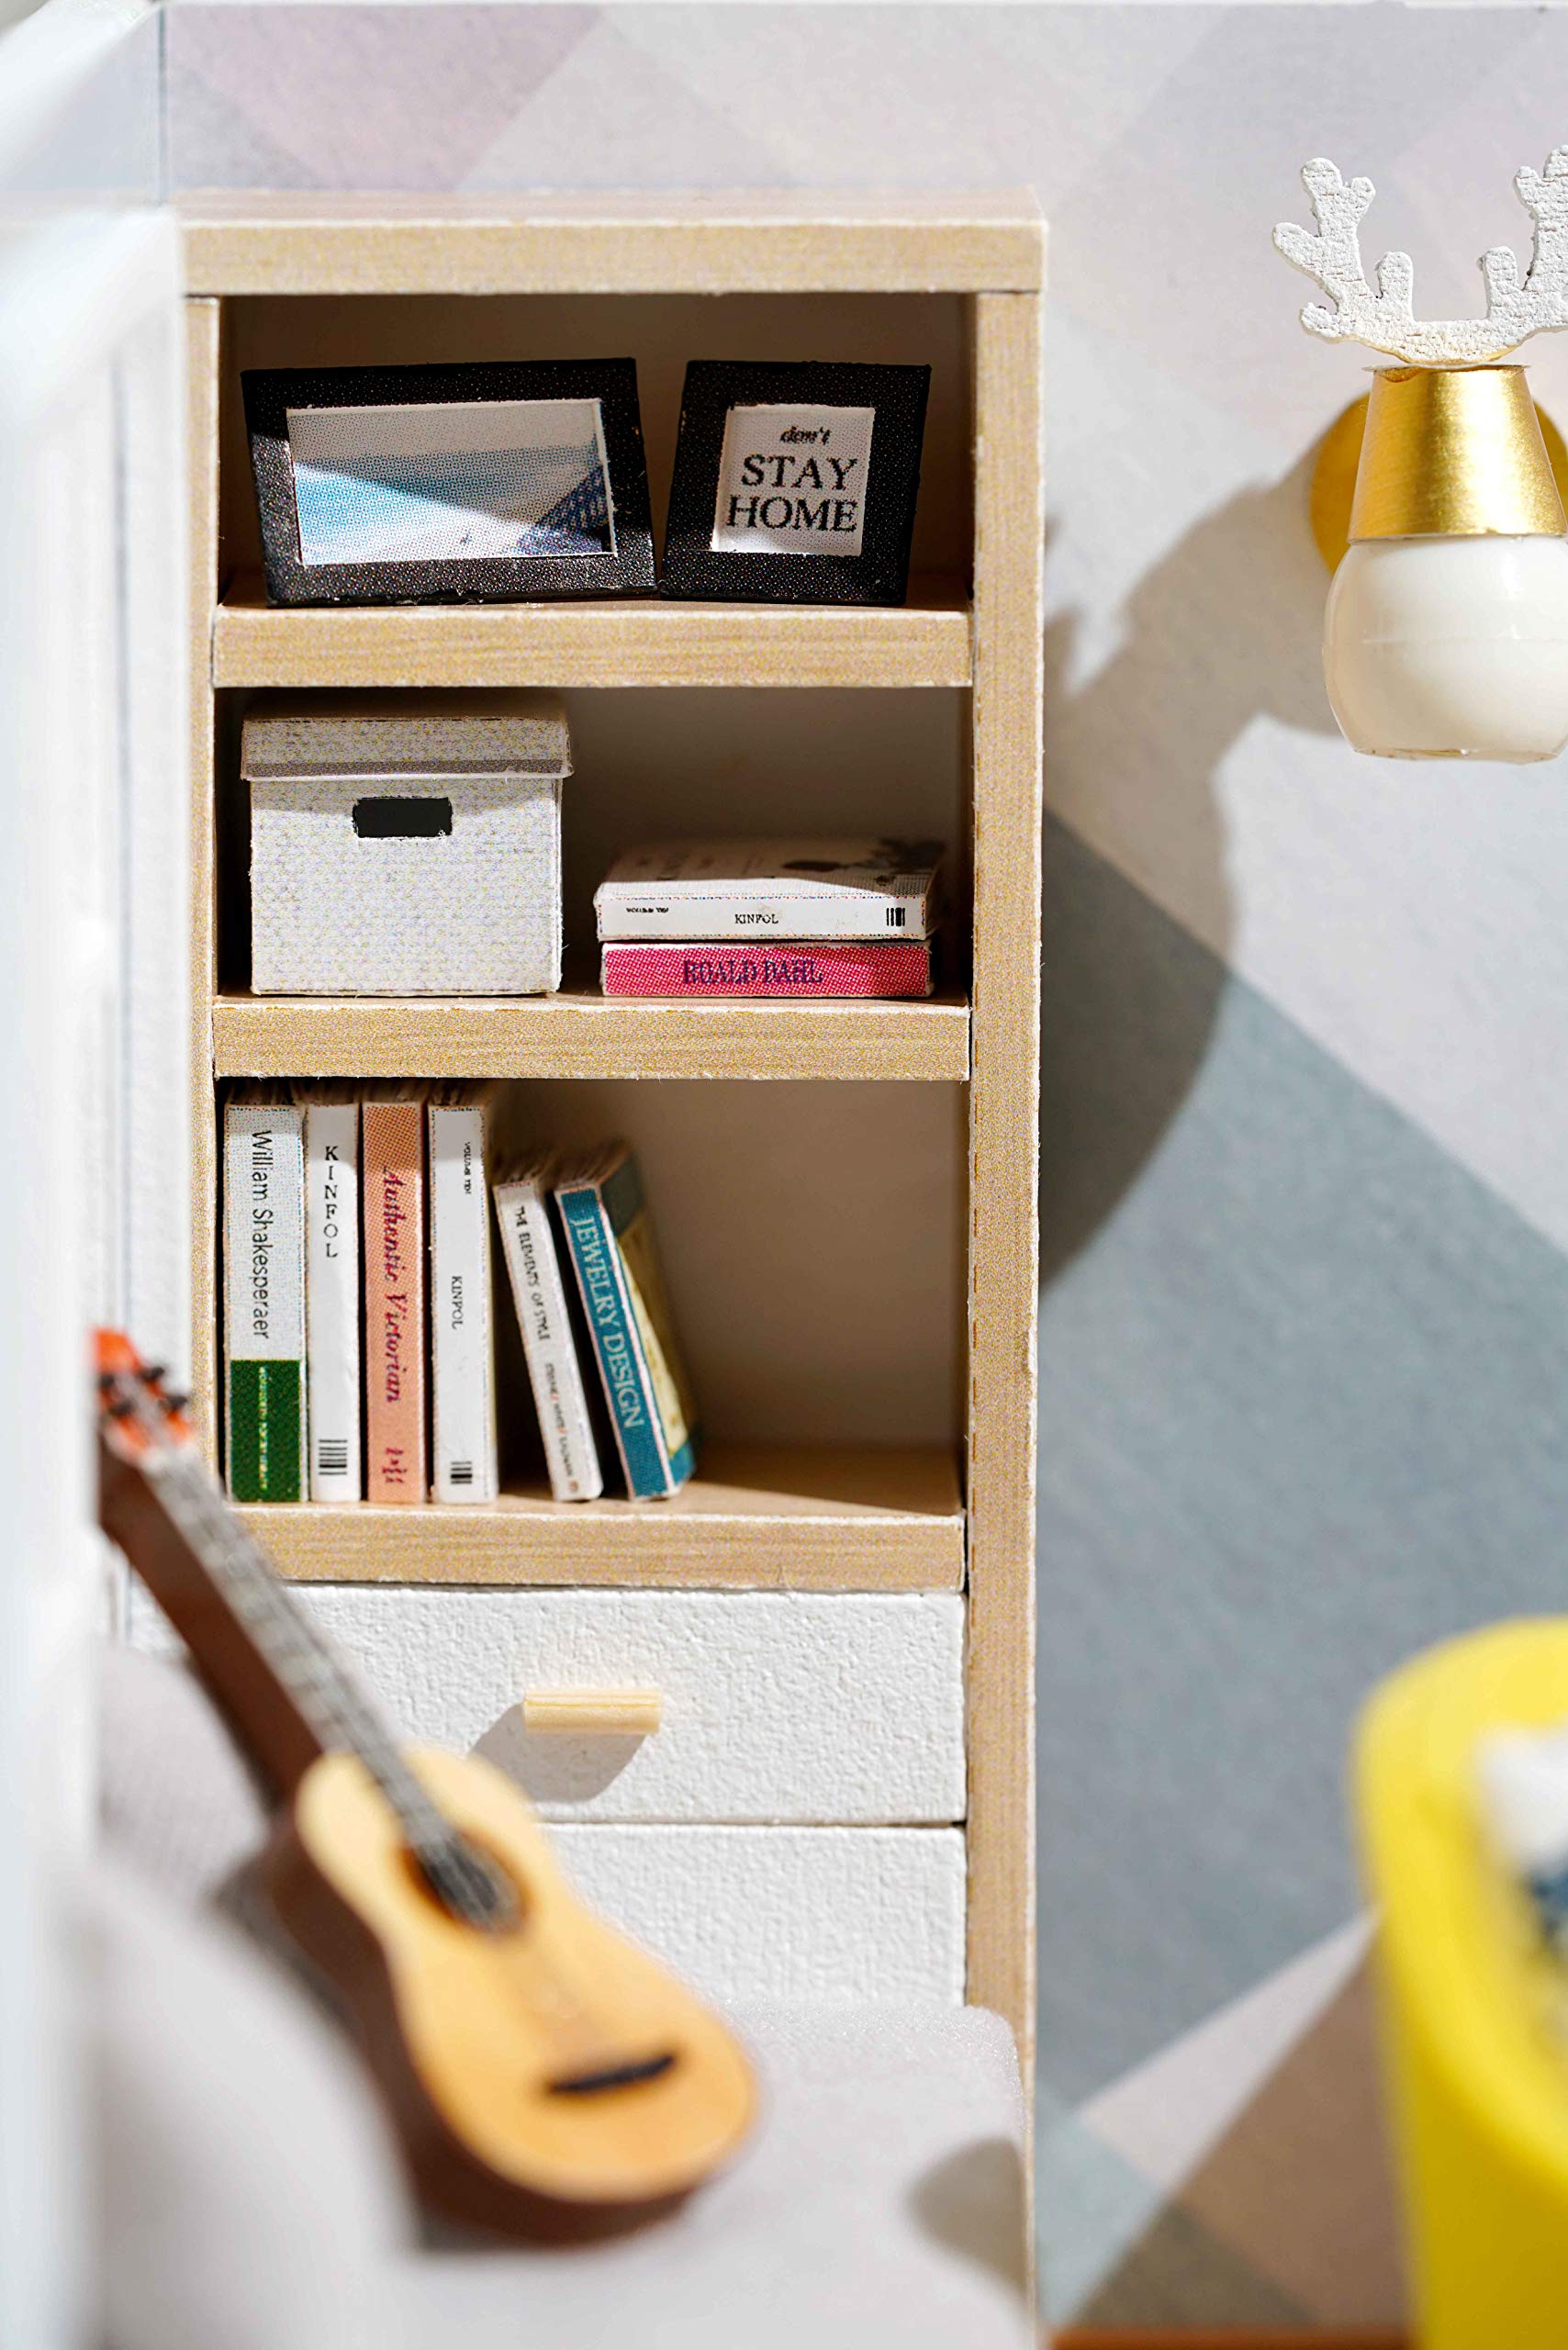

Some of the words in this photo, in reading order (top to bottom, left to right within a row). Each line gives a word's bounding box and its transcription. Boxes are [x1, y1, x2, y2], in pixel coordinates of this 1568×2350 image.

[741, 453, 857, 490] STAY
[726, 494, 857, 532] HOME
[683, 960, 756, 984] ROALD
[764, 960, 823, 983] DAHL
[252, 1130, 273, 1201] William
[324, 1146, 339, 1258] KINFOL
[383, 1168, 407, 1281] Authentic
[515, 1206, 528, 1227] THE
[251, 1208, 273, 1338] Shakesperaer
[518, 1231, 540, 1287] ELEMENTS
[386, 1293, 408, 1403] Victorian
[533, 1310, 550, 1341] STYLE
[570, 1214, 621, 1328] JEWELRY
[602, 1332, 644, 1429] DESIGN
